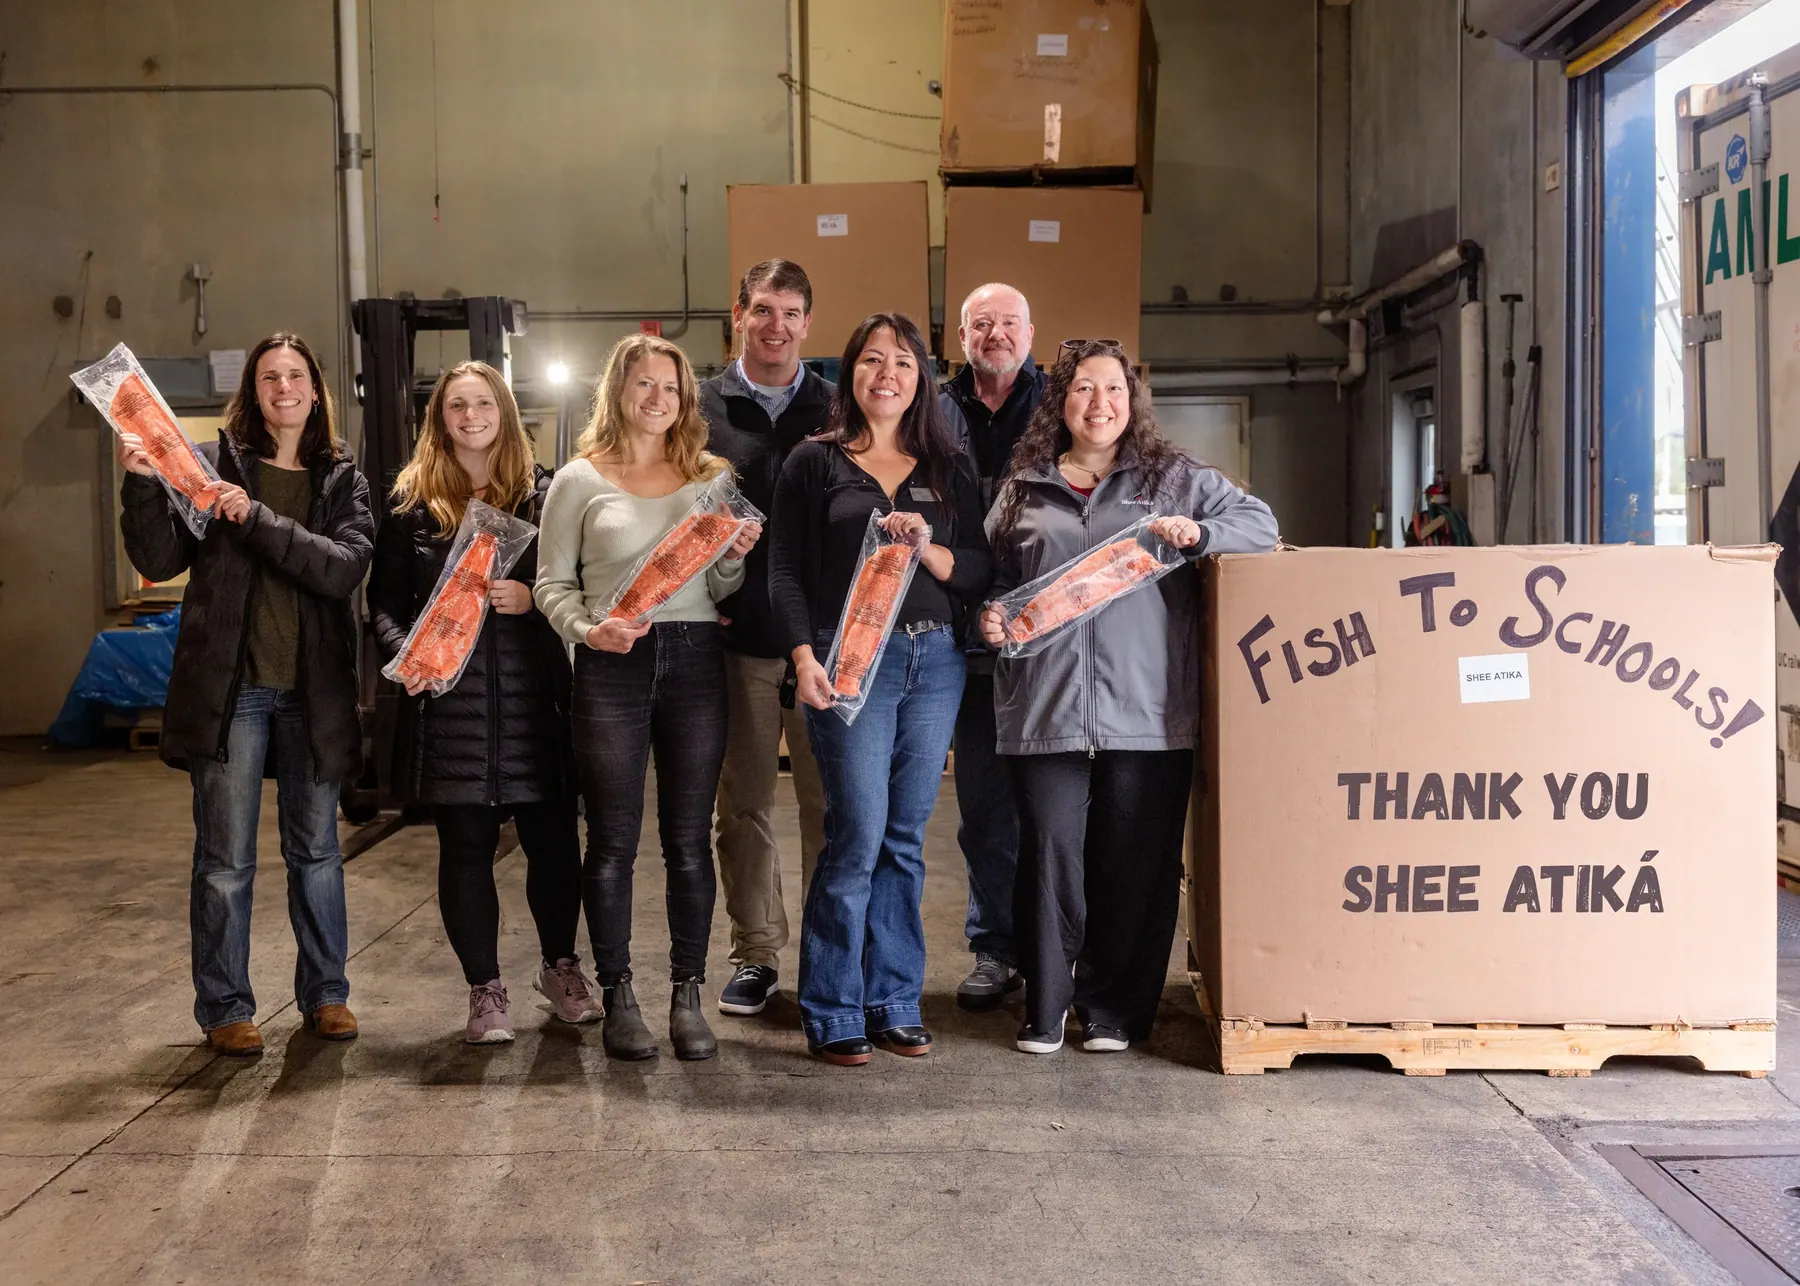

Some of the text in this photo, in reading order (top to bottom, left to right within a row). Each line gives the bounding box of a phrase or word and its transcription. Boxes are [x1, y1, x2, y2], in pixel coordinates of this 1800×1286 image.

[1466, 671, 1523, 682] SHEE ATIKA
[1337, 772, 1649, 821] THANK YOU
[1342, 850, 1664, 913] SHEE ATIKÁ
